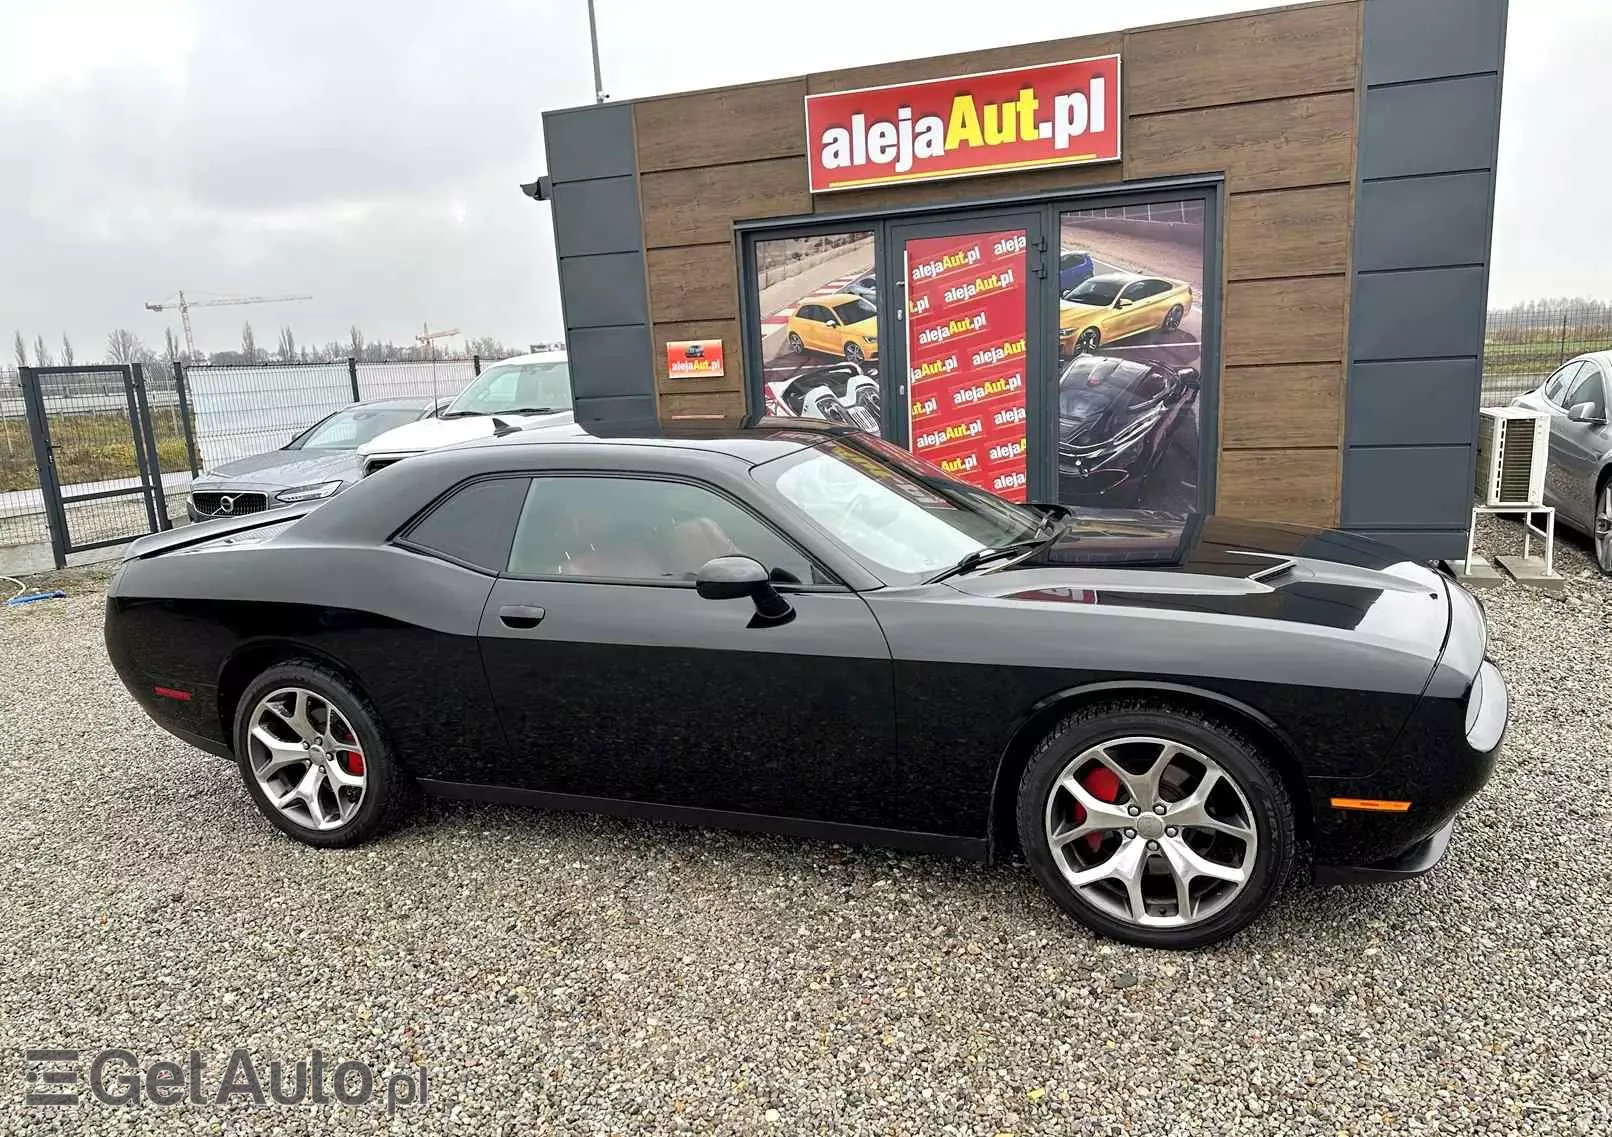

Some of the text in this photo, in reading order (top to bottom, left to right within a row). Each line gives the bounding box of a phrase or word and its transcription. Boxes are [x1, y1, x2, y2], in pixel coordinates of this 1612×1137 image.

[821, 77, 1105, 172] alejaAut.pl
[912, 246, 980, 280] alejaAut.pl
[944, 268, 1014, 303] alejaAut.pl
[919, 312, 987, 344] alejaAut.pl
[953, 373, 1022, 404] alejaAut.pl
[917, 420, 982, 448] alejaAut.pl
